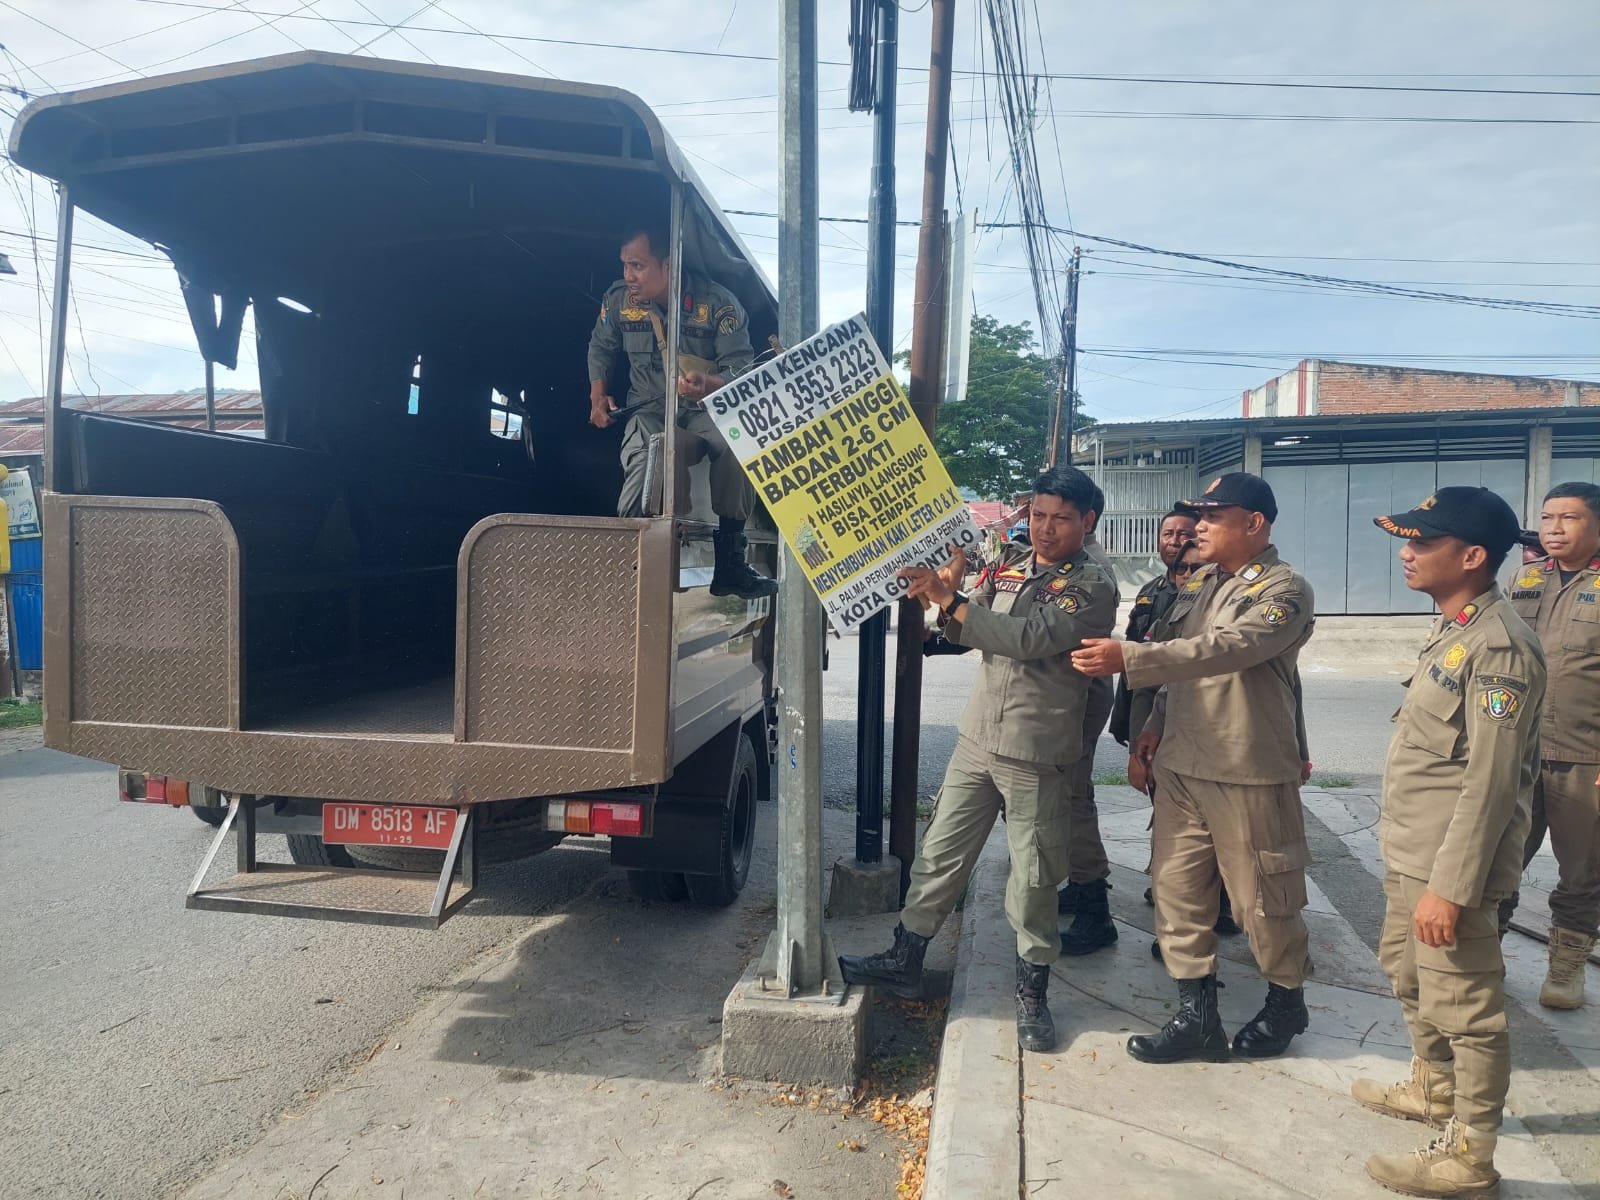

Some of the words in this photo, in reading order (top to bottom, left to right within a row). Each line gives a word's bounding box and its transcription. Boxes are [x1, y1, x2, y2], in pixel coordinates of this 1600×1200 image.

[712, 370, 777, 416] SURYA
[776, 319, 862, 380] KENCANA
[738, 391, 789, 438] 0821
[785, 364, 834, 411] 3553
[830, 338, 877, 385] 2323
[757, 407, 815, 449] PUSAT
[819, 367, 882, 410] TERAPI
[746, 420, 834, 483] TAMBAH
[830, 378, 899, 432] TINGGI
[763, 445, 841, 505] BADAN
[842, 424, 876, 457] 2-6
[877, 401, 911, 432] CM
[805, 439, 895, 504] TERBUKTI
[816, 481, 873, 525] HASILNYA
[870, 444, 928, 490] LANGSUNG
[832, 509, 871, 537] BISA
[869, 465, 927, 513] DILIHAT
[853, 526, 870, 543] DI
[869, 492, 919, 531] TEMPAT
[812, 535, 889, 595] MENYEMBUHKAN
[884, 520, 910, 548] KAKI
[909, 503, 938, 531] LETER
[939, 493, 950, 509] &
[946, 487, 959, 504] X
[839, 580, 868, 605] PALMA
[864, 549, 914, 585] PERUMAHAN
[912, 532, 939, 557] ALTIRA
[937, 514, 965, 538] PERMAI
[962, 508, 970, 521] 3
[840, 592, 885, 627] KOTA
[334, 807, 359, 830] DM
[371, 808, 413, 832] 8513
[424, 810, 447, 834] AF
